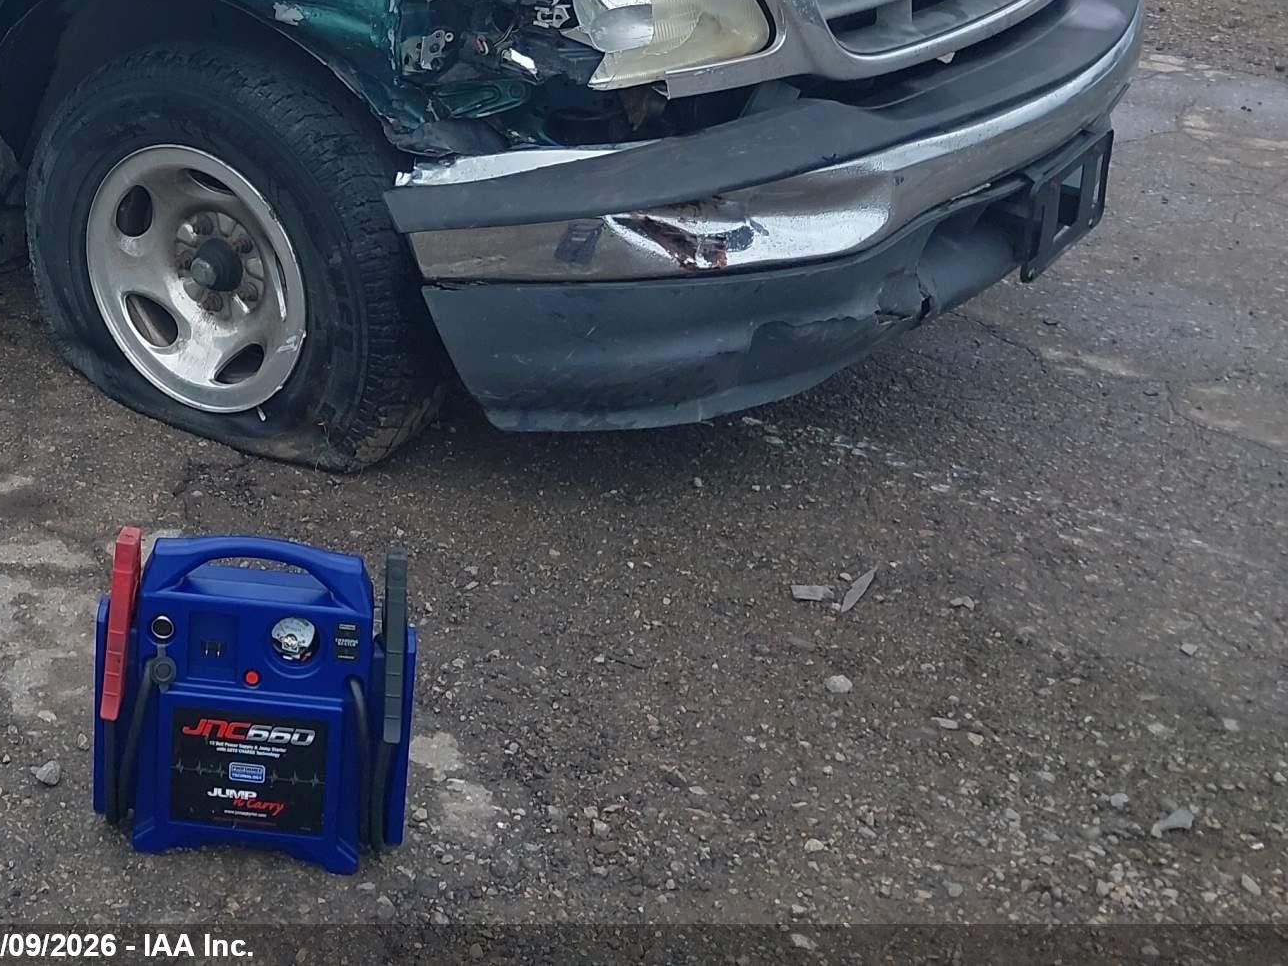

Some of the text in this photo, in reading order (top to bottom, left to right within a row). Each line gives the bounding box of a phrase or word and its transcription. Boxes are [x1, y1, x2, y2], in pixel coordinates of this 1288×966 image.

[182, 719, 315, 746] JNC660
[207, 788, 257, 800] JUMP
[246, 800, 284, 816] Carry
